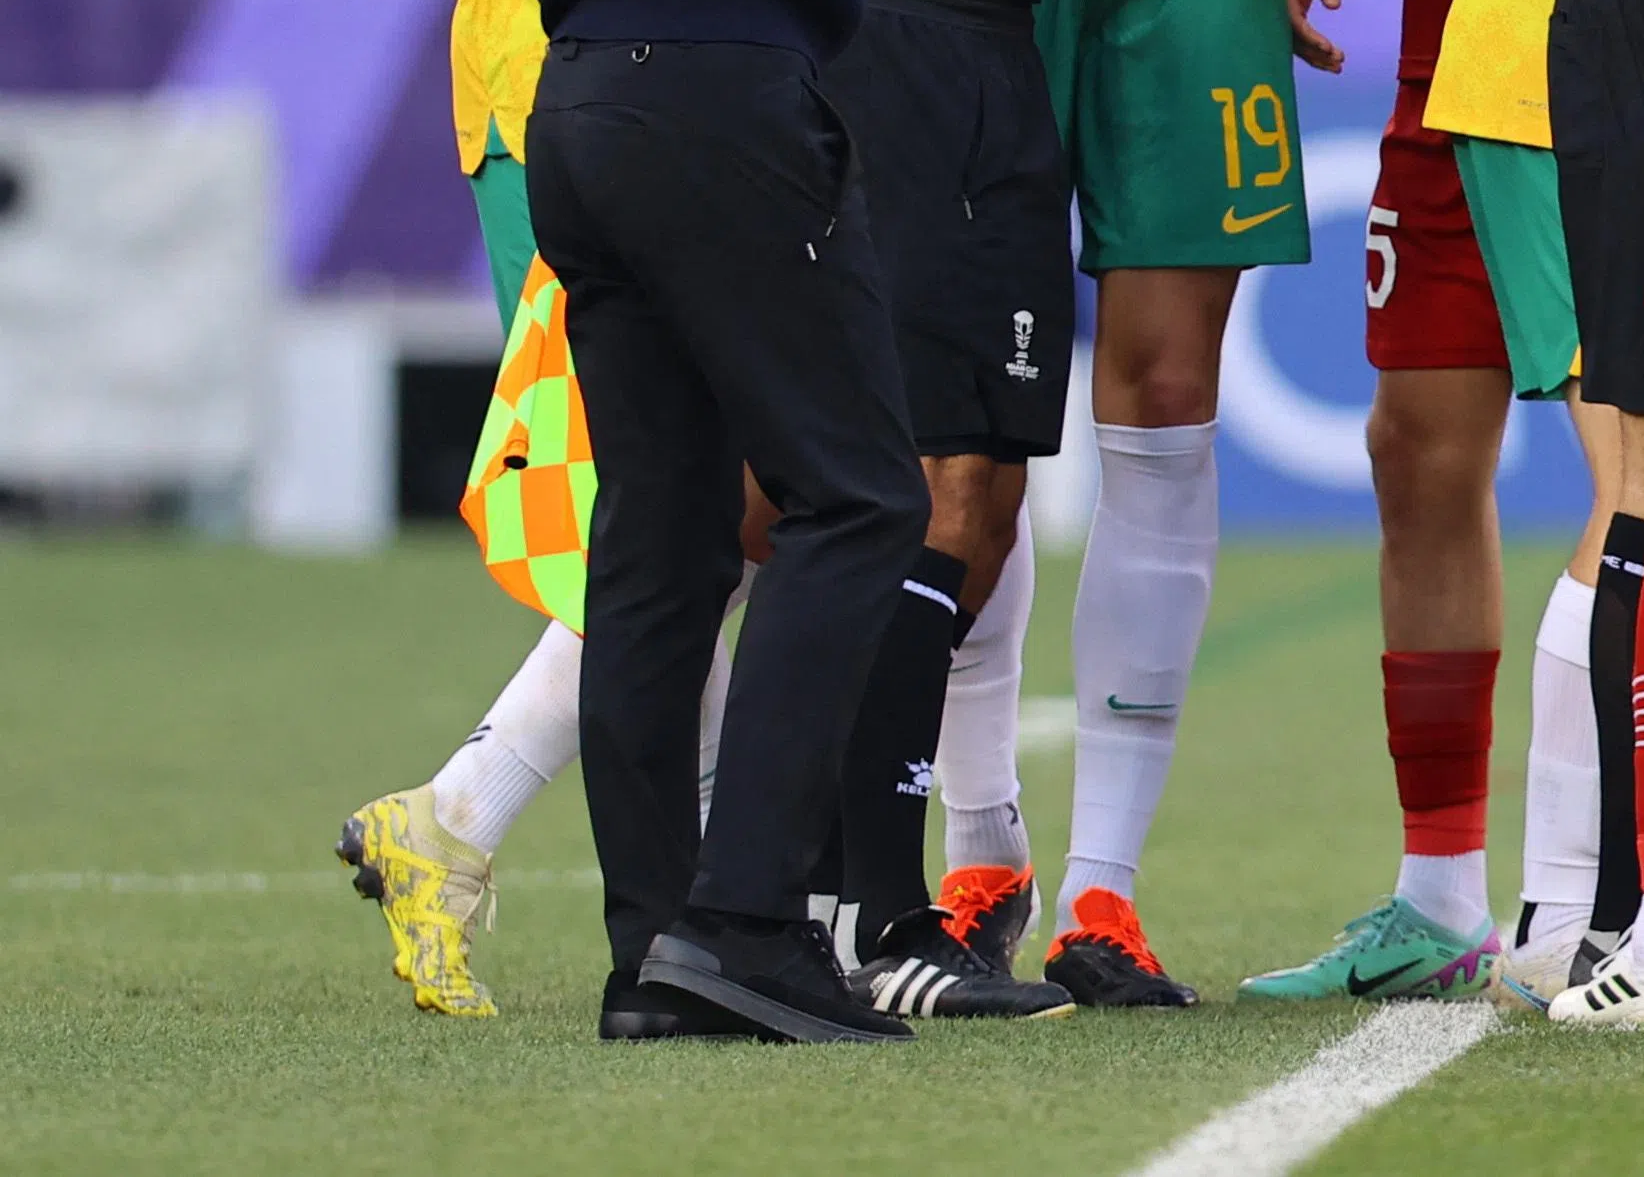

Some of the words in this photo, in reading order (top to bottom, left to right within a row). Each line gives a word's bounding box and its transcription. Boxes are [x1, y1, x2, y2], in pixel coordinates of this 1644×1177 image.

[1211, 83, 1292, 189] 19
[1365, 204, 1399, 309] 5
[896, 781, 930, 797] KEL
